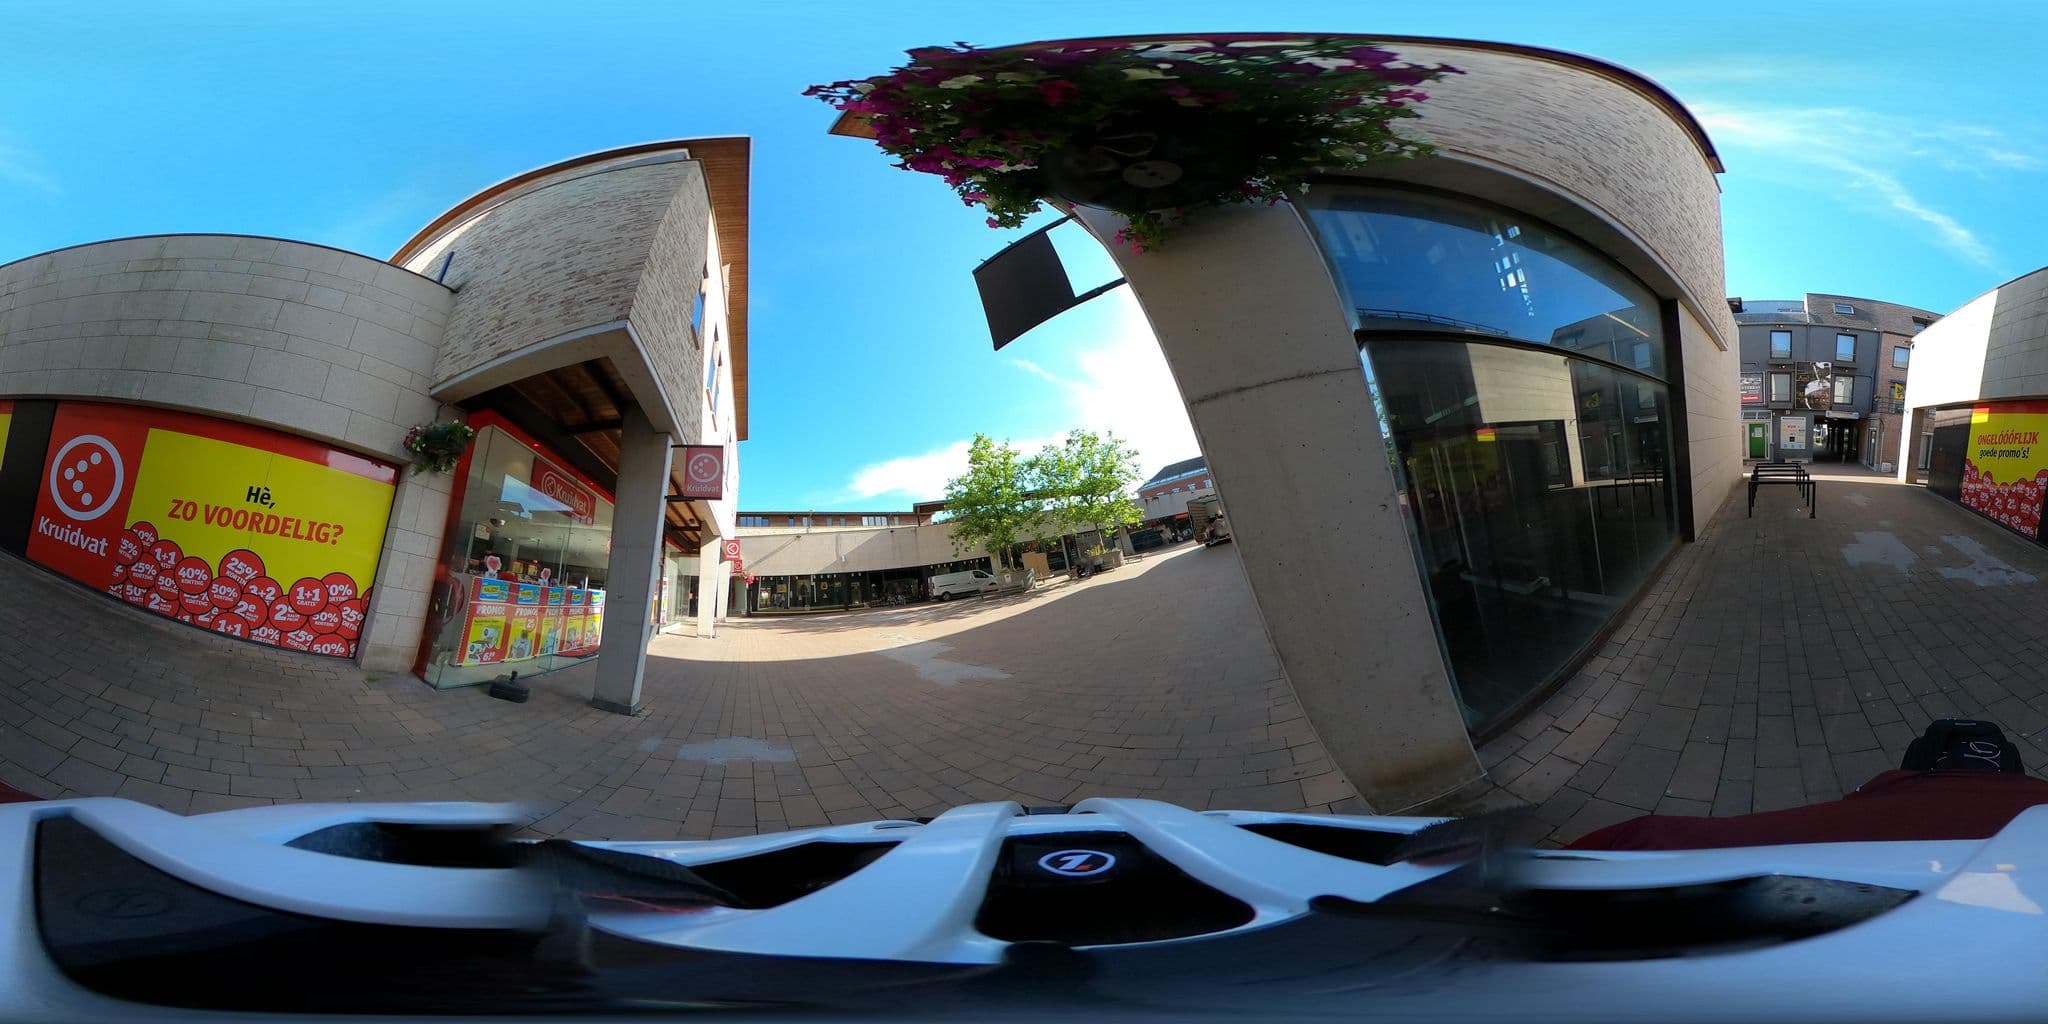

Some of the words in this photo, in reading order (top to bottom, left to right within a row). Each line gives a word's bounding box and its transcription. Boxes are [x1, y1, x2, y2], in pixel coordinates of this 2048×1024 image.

[1977, 429, 2040, 446] ONGELÓÓÓFLIJK
[1979, 447, 1997, 459] goede
[1998, 447, 2030, 460] promo's!
[686, 484, 720, 493] Kruidvat
[245, 486, 276, 509] Hè,
[555, 484, 586, 513] Kruidvat
[167, 498, 198, 522] ZO
[203, 504, 345, 545] VOORDELIG?
[37, 515, 108, 557] Kruidvat
[121, 538, 138, 556] 5%
[155, 548, 176, 565] 1+1
[178, 567, 209, 582] 40%
[225, 570, 248, 586] KORTIN
[211, 583, 238, 598] 50%
[249, 585, 276, 601] 3+2
[296, 586, 320, 602] 1+1
[326, 584, 353, 597] 0%
[476, 605, 506, 616] PROMO!
[217, 619, 242, 637] 1+1
[313, 642, 345, 655] 50%
